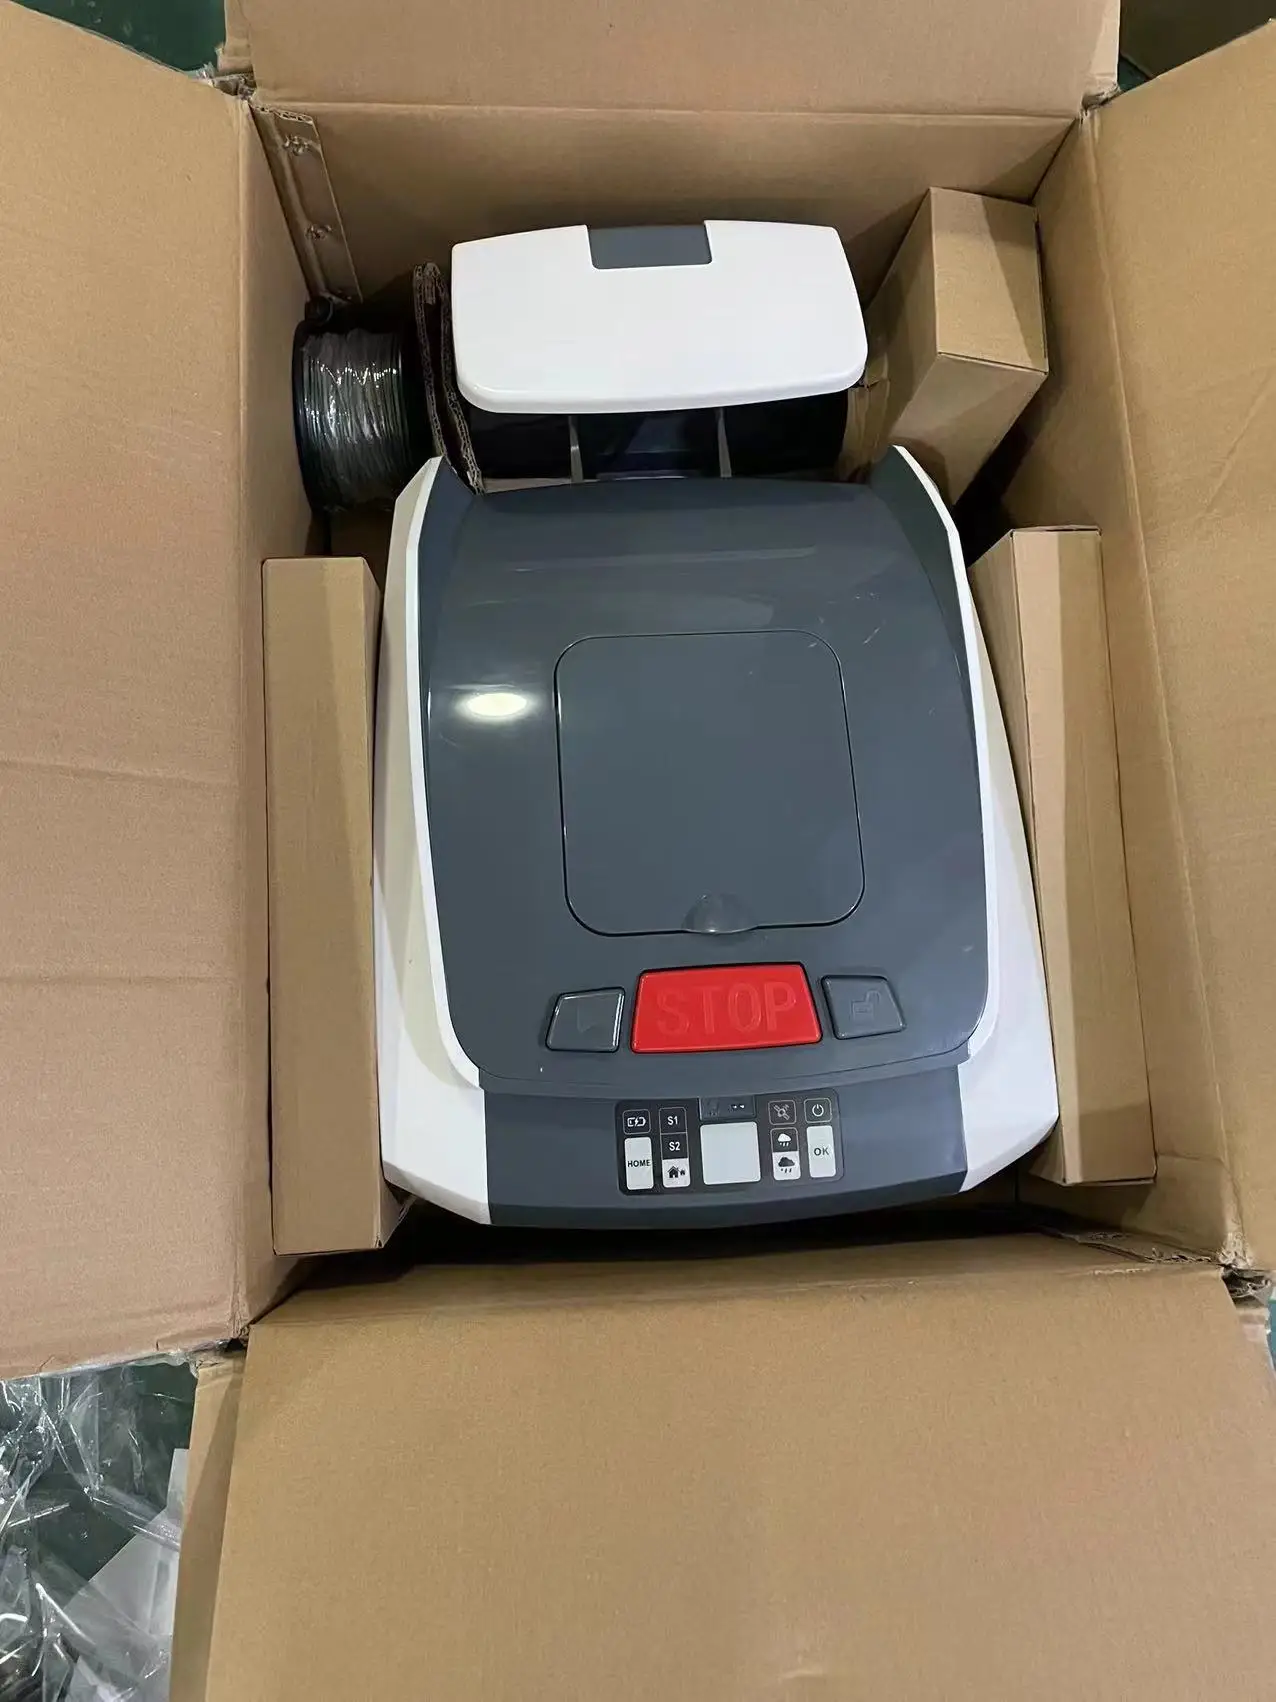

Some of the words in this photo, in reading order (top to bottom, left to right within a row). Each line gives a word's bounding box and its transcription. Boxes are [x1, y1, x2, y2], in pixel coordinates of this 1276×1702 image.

[656, 980, 797, 1035] STOP
[667, 1115, 678, 1126] S1
[669, 1141, 681, 1151] S2
[813, 1147, 830, 1156] OK
[627, 1159, 651, 1168] HOME
